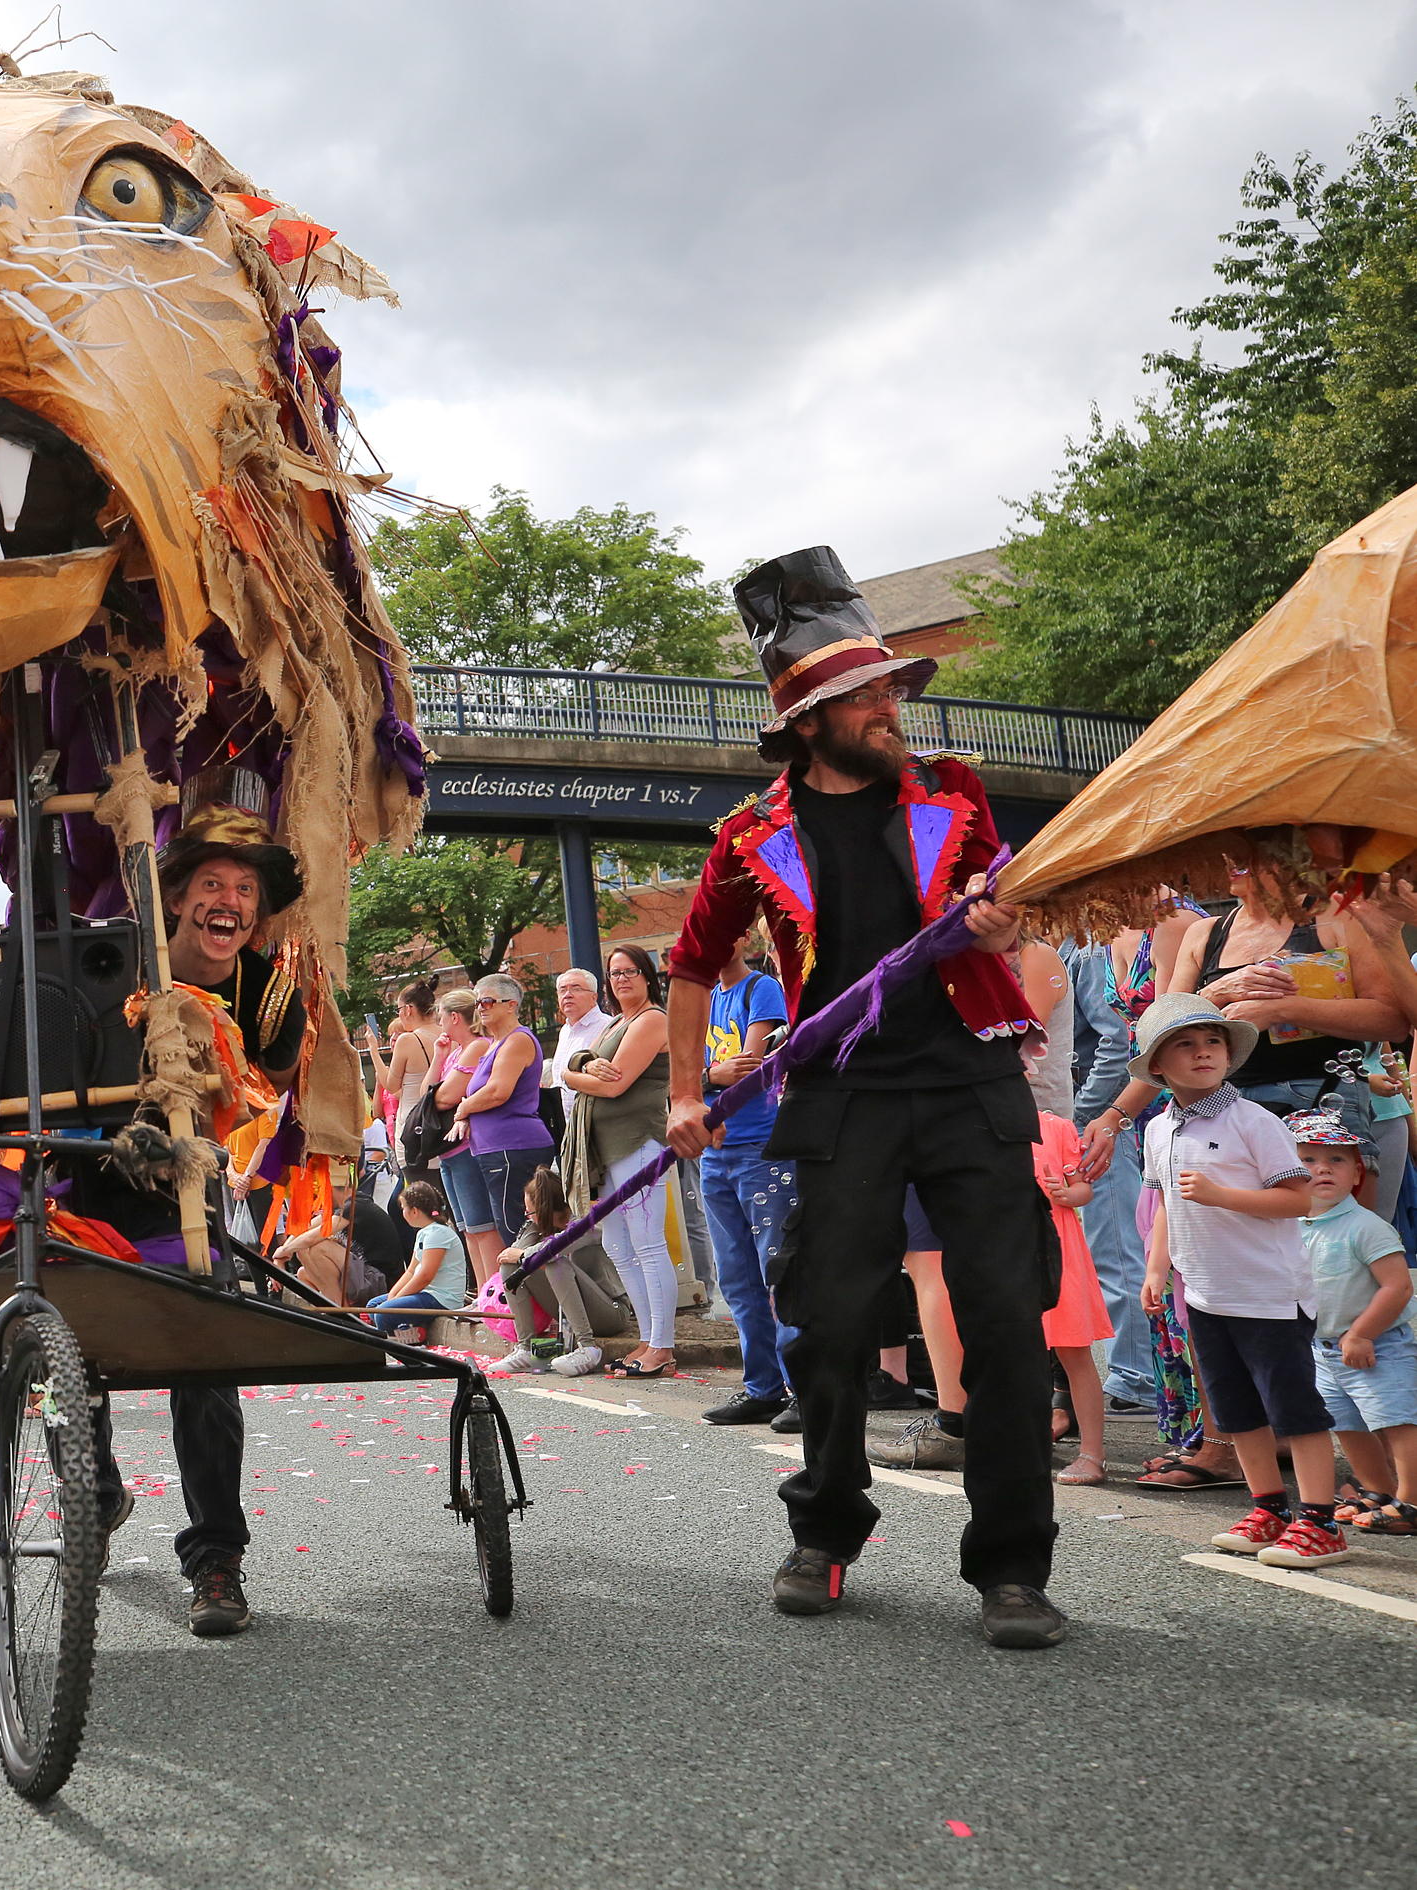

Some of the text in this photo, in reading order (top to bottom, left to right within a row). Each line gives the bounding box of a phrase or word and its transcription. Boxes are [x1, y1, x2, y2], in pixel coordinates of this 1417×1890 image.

[440, 774, 703, 808] ecclesiastes chapter 1 vs.7
